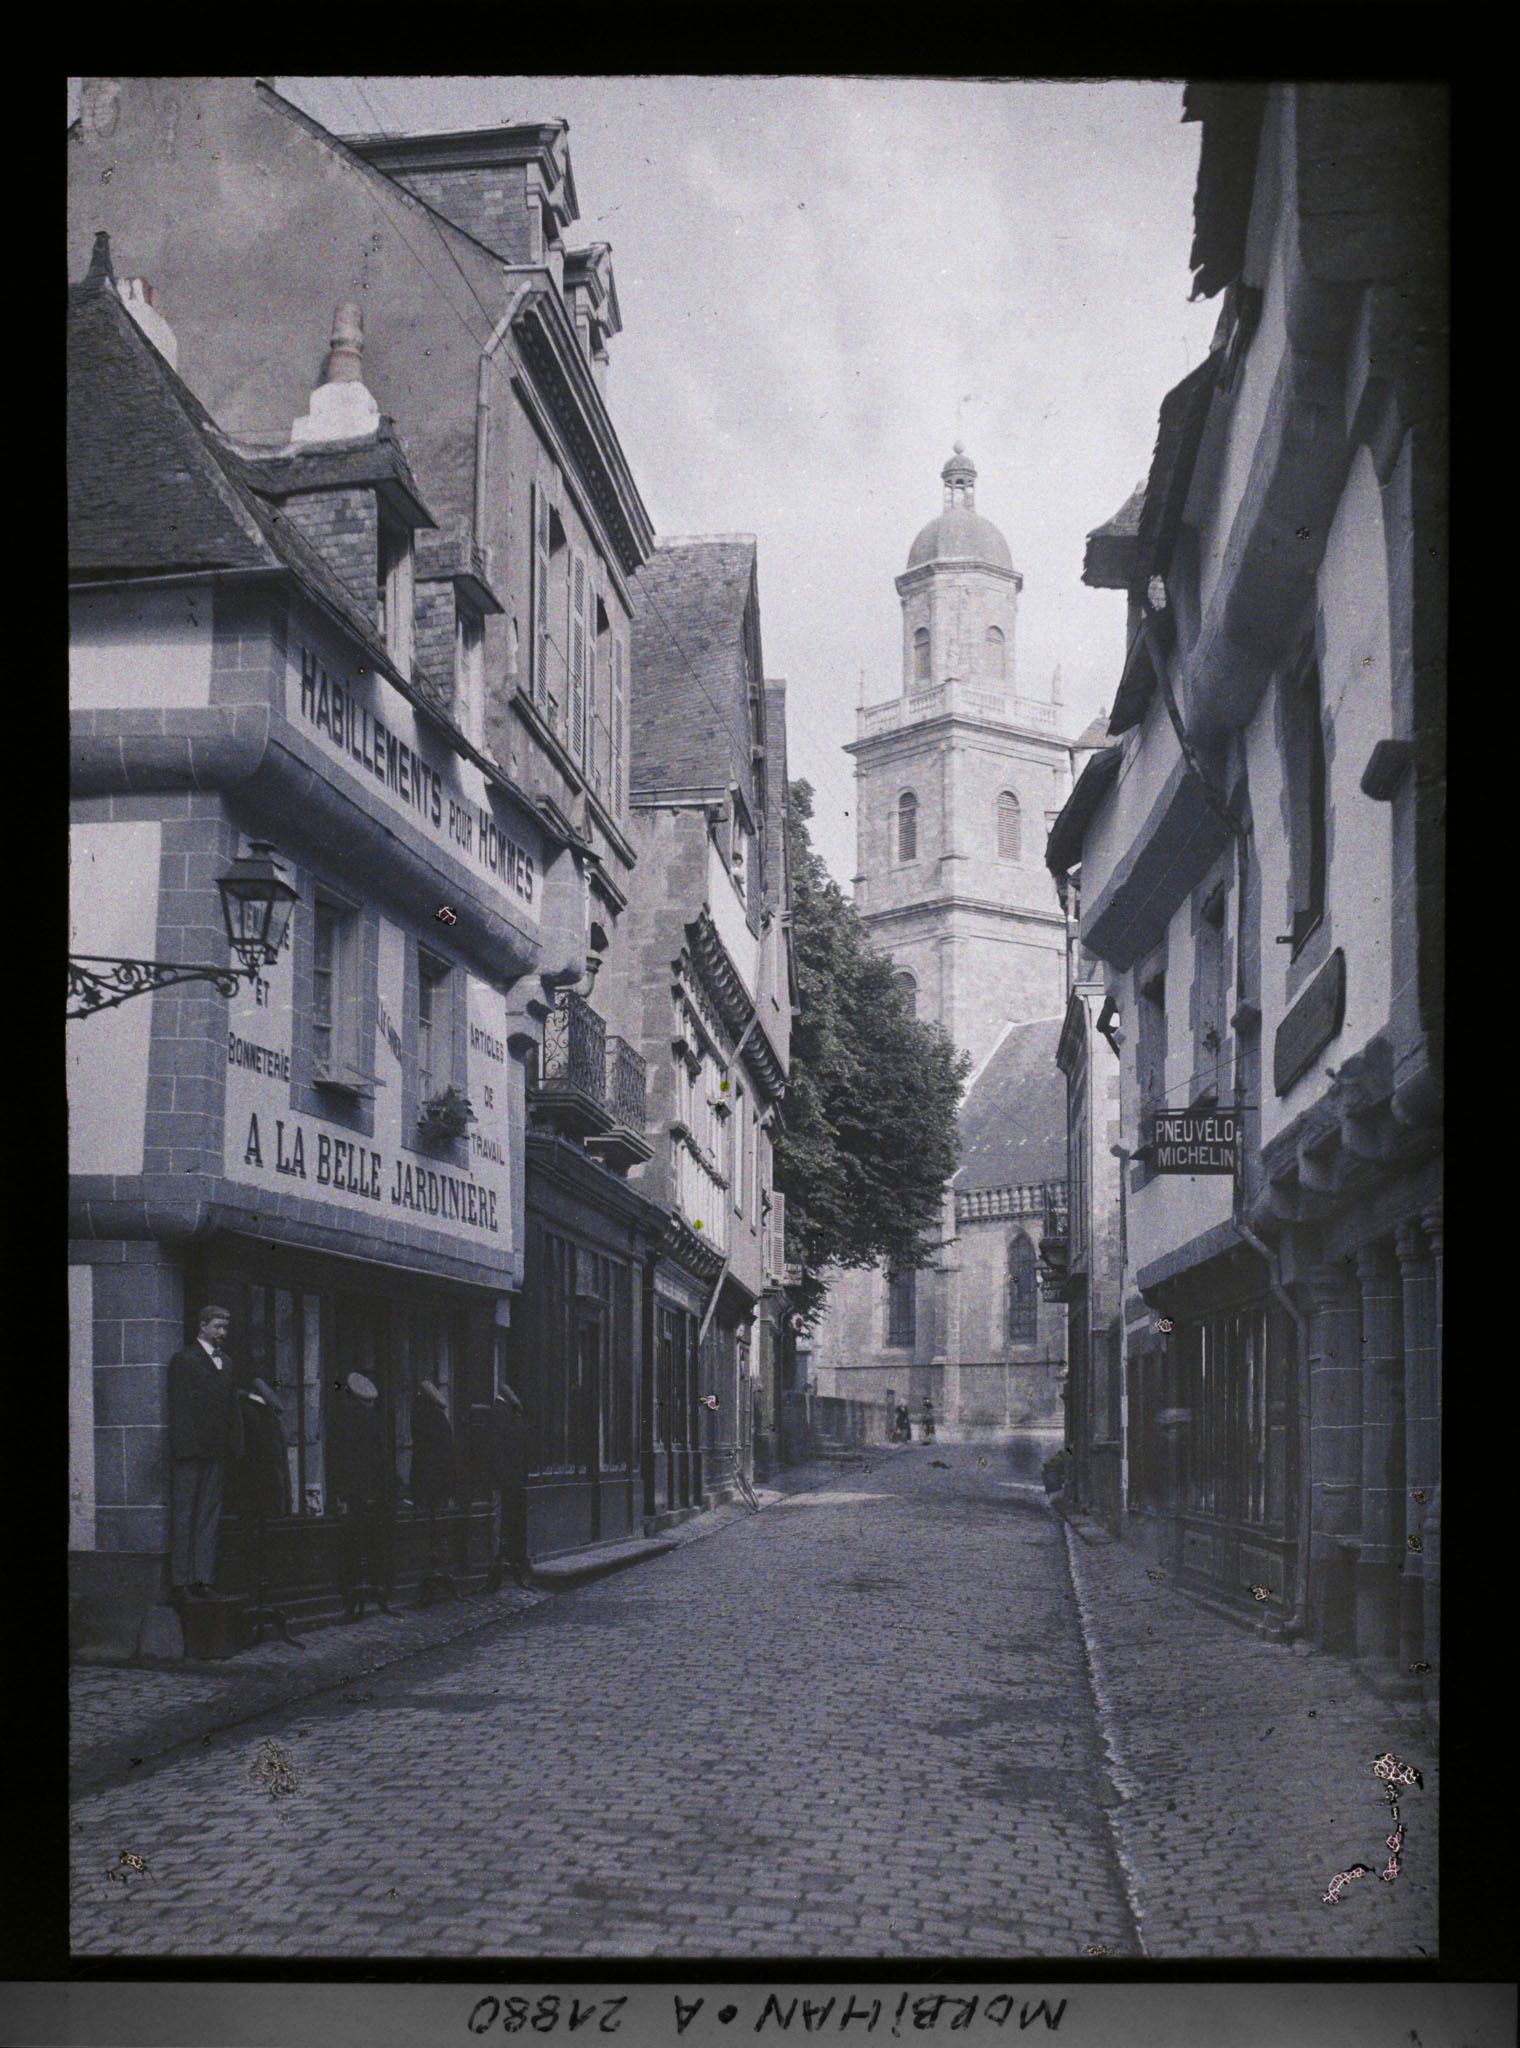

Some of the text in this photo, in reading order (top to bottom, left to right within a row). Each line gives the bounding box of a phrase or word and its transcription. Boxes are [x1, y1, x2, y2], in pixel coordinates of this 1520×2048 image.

[449, 799, 474, 854] POUR
[478, 806, 534, 904] HOMMES
[256, 976, 270, 1008] ET
[228, 1031, 290, 1082] BONNETERIE
[470, 1022, 505, 1065] ARTICLES
[484, 1085, 494, 1110] DE
[471, 1131, 505, 1166] TRAVAIL
[1155, 1117, 1234, 1142] PNEU VÉLO
[244, 1112, 498, 1233] A LA BELLE JARDINIÈRE
[1158, 1146, 1234, 1168] MICHELIN
[467, 1995, 628, 2034] 21880
[673, 1994, 705, 2033] A
